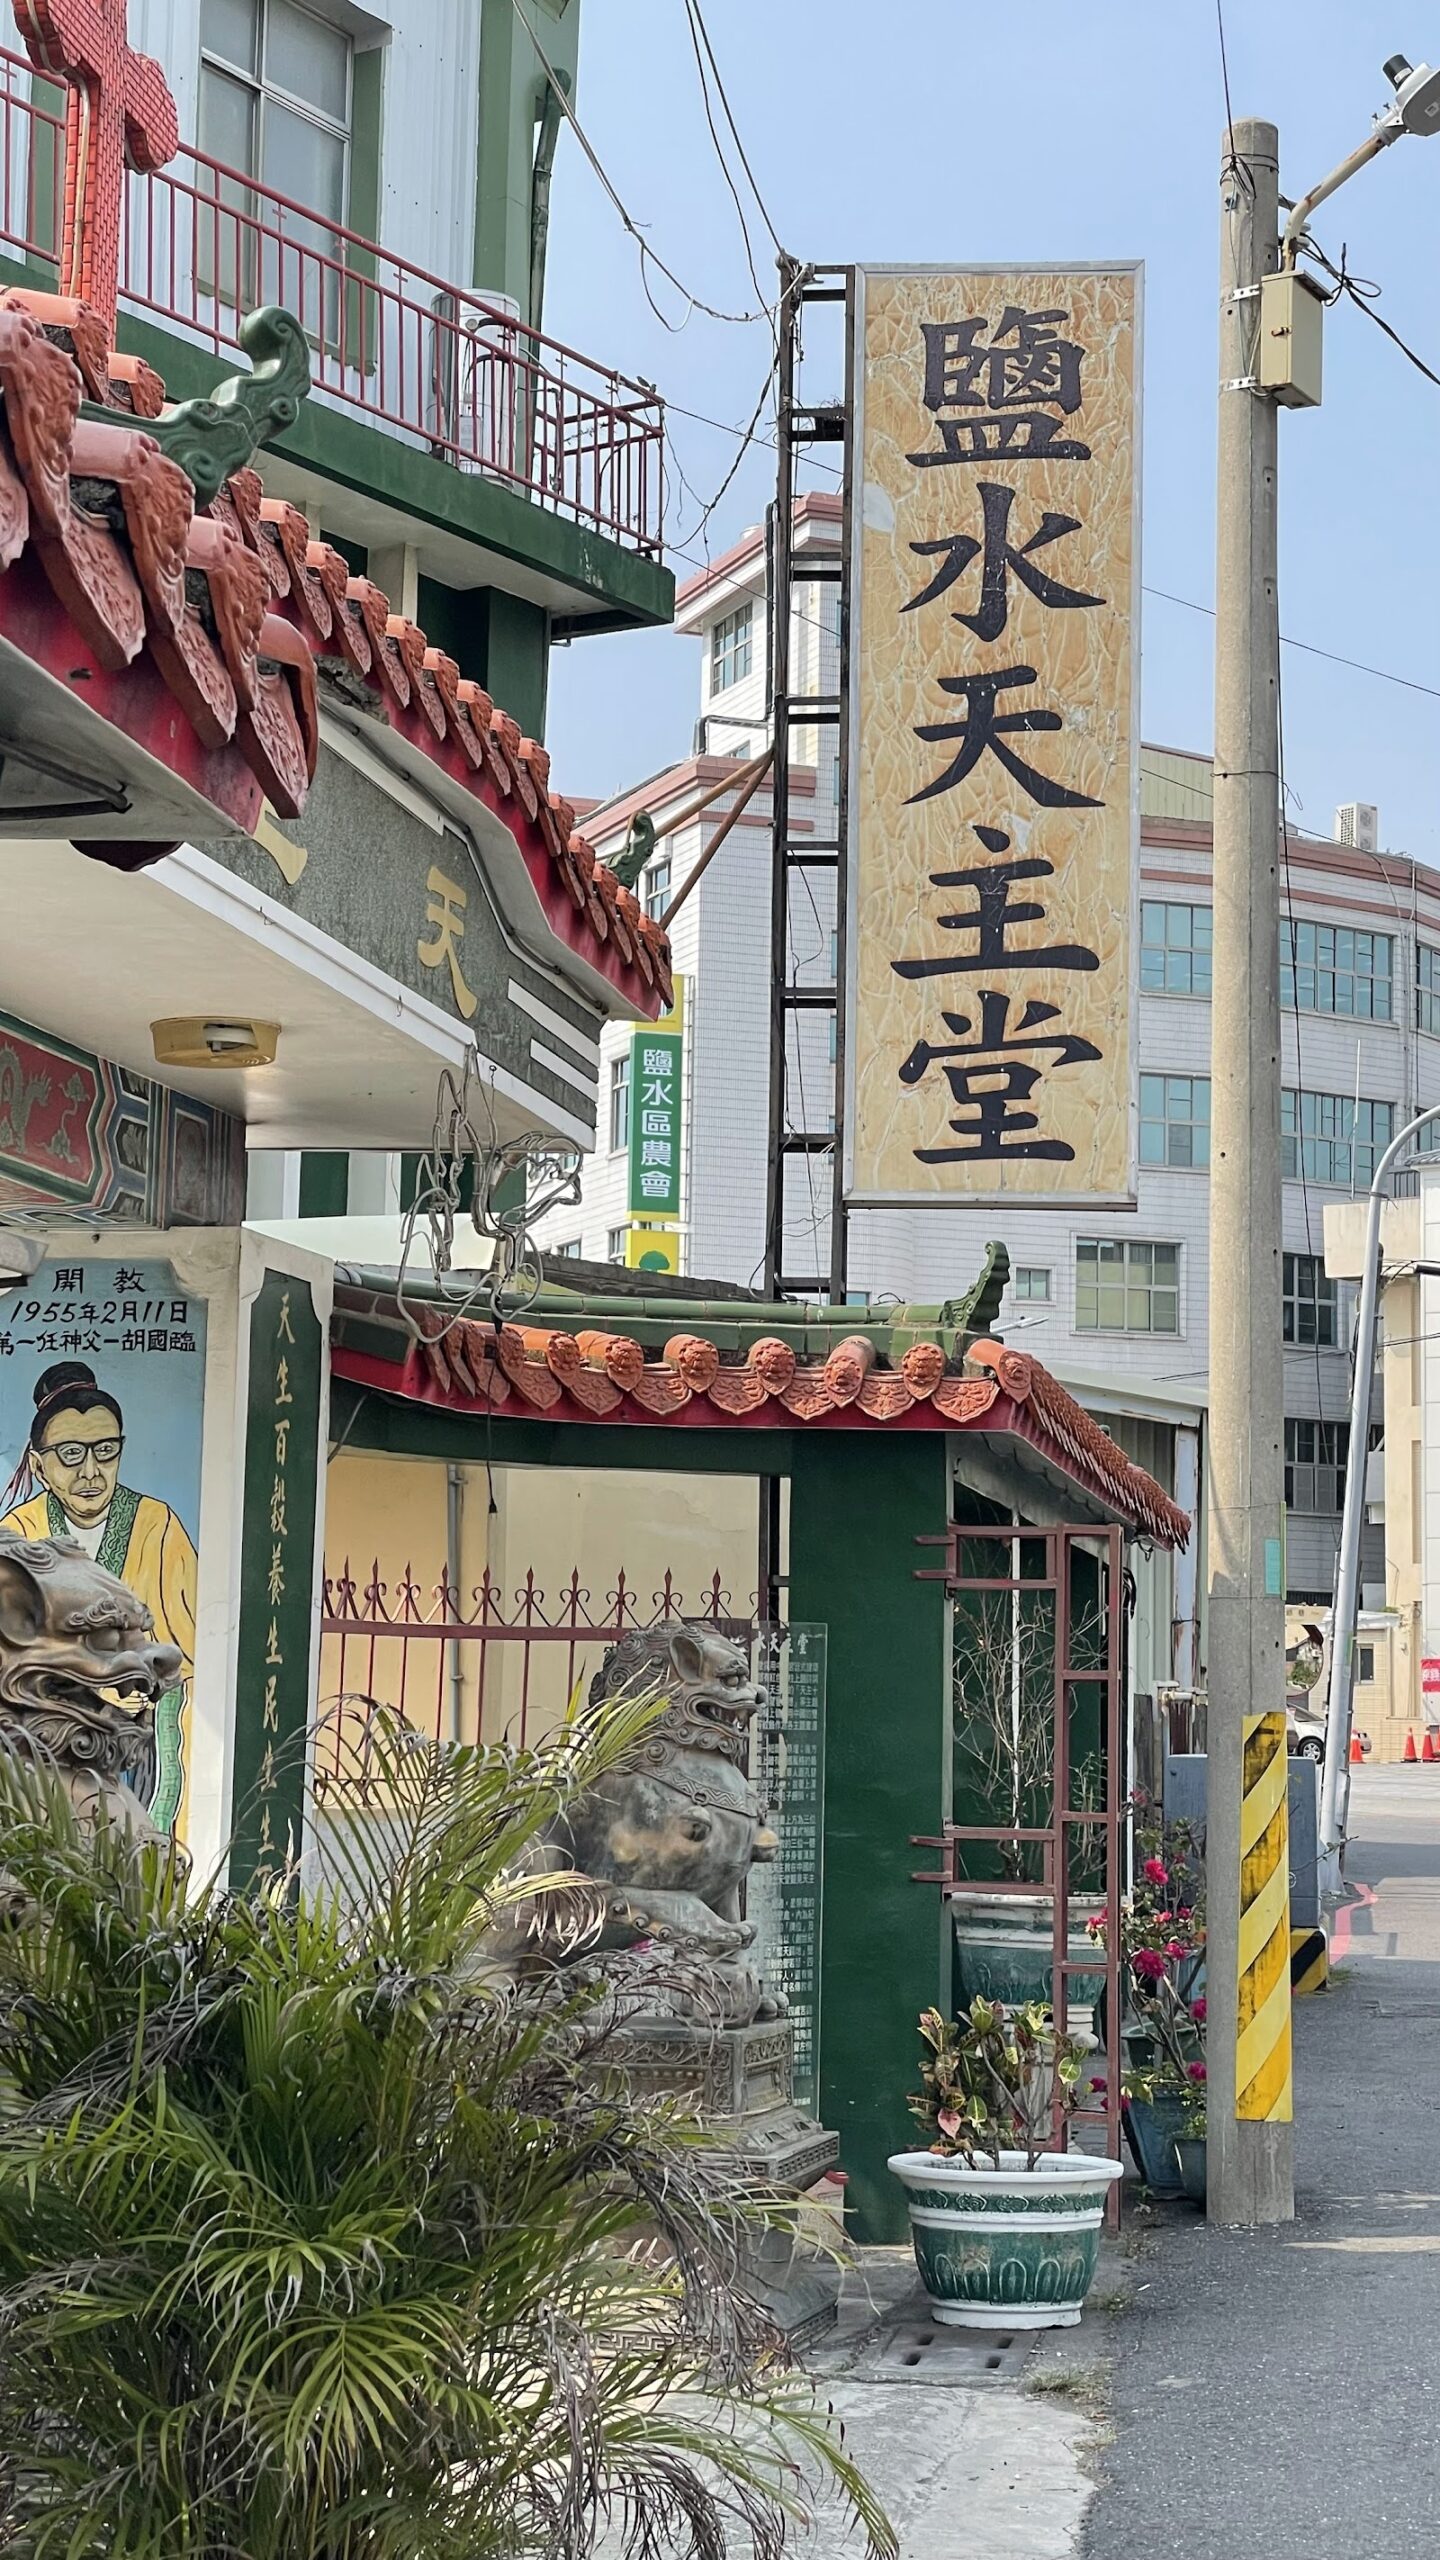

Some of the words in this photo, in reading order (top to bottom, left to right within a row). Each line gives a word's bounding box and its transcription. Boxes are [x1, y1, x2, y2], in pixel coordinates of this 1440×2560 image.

[890, 306, 1107, 1164] 鹽水天主堂
[640, 1047, 674, 1198] 鹽水區農會
[10, 1299, 188, 1325] 1955年2月11日
